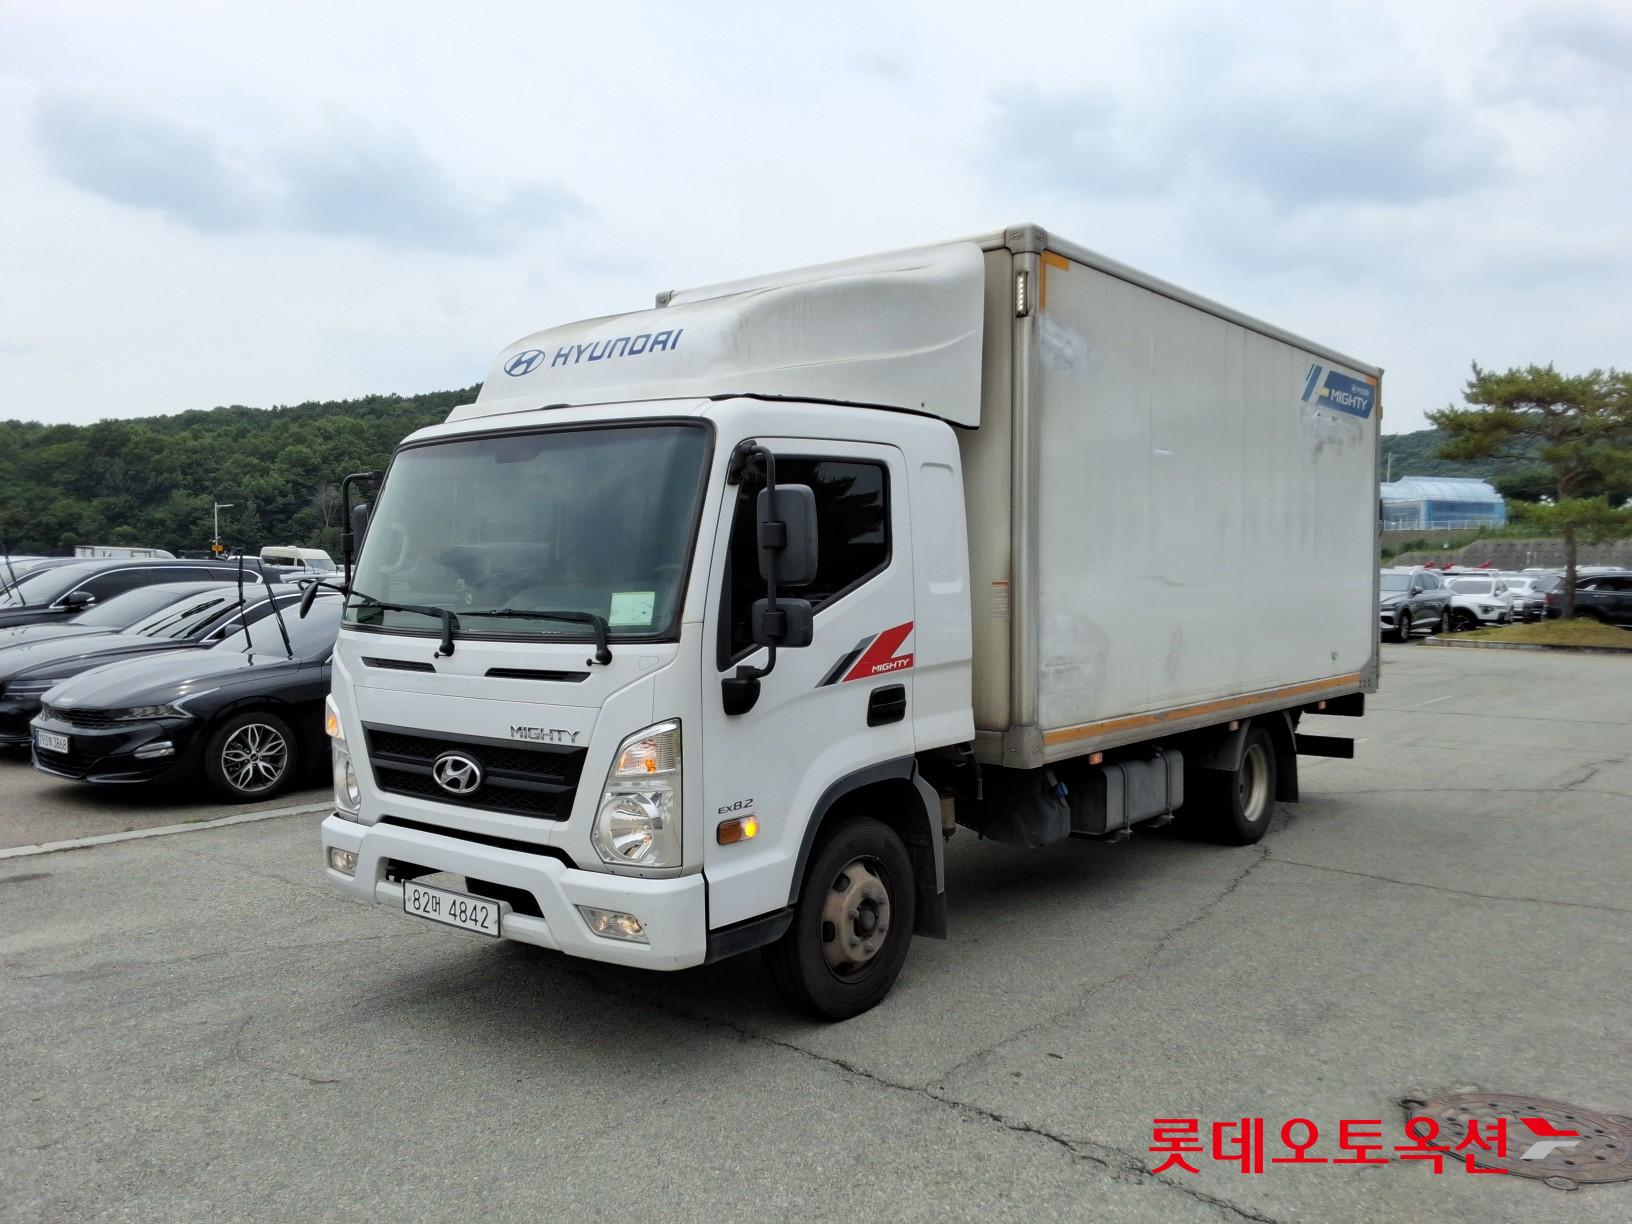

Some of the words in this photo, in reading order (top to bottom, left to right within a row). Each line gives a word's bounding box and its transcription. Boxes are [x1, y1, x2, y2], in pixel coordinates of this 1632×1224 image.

[551, 329, 684, 367] HYUNDAI
[1330, 389, 1368, 411] MIGHTY
[871, 658, 909, 673] MIGHTY
[510, 725, 580, 743] MIGHTY
[717, 798, 754, 814] EX8.2
[413, 889, 440, 916] 82머
[448, 899, 489, 929] 4842
